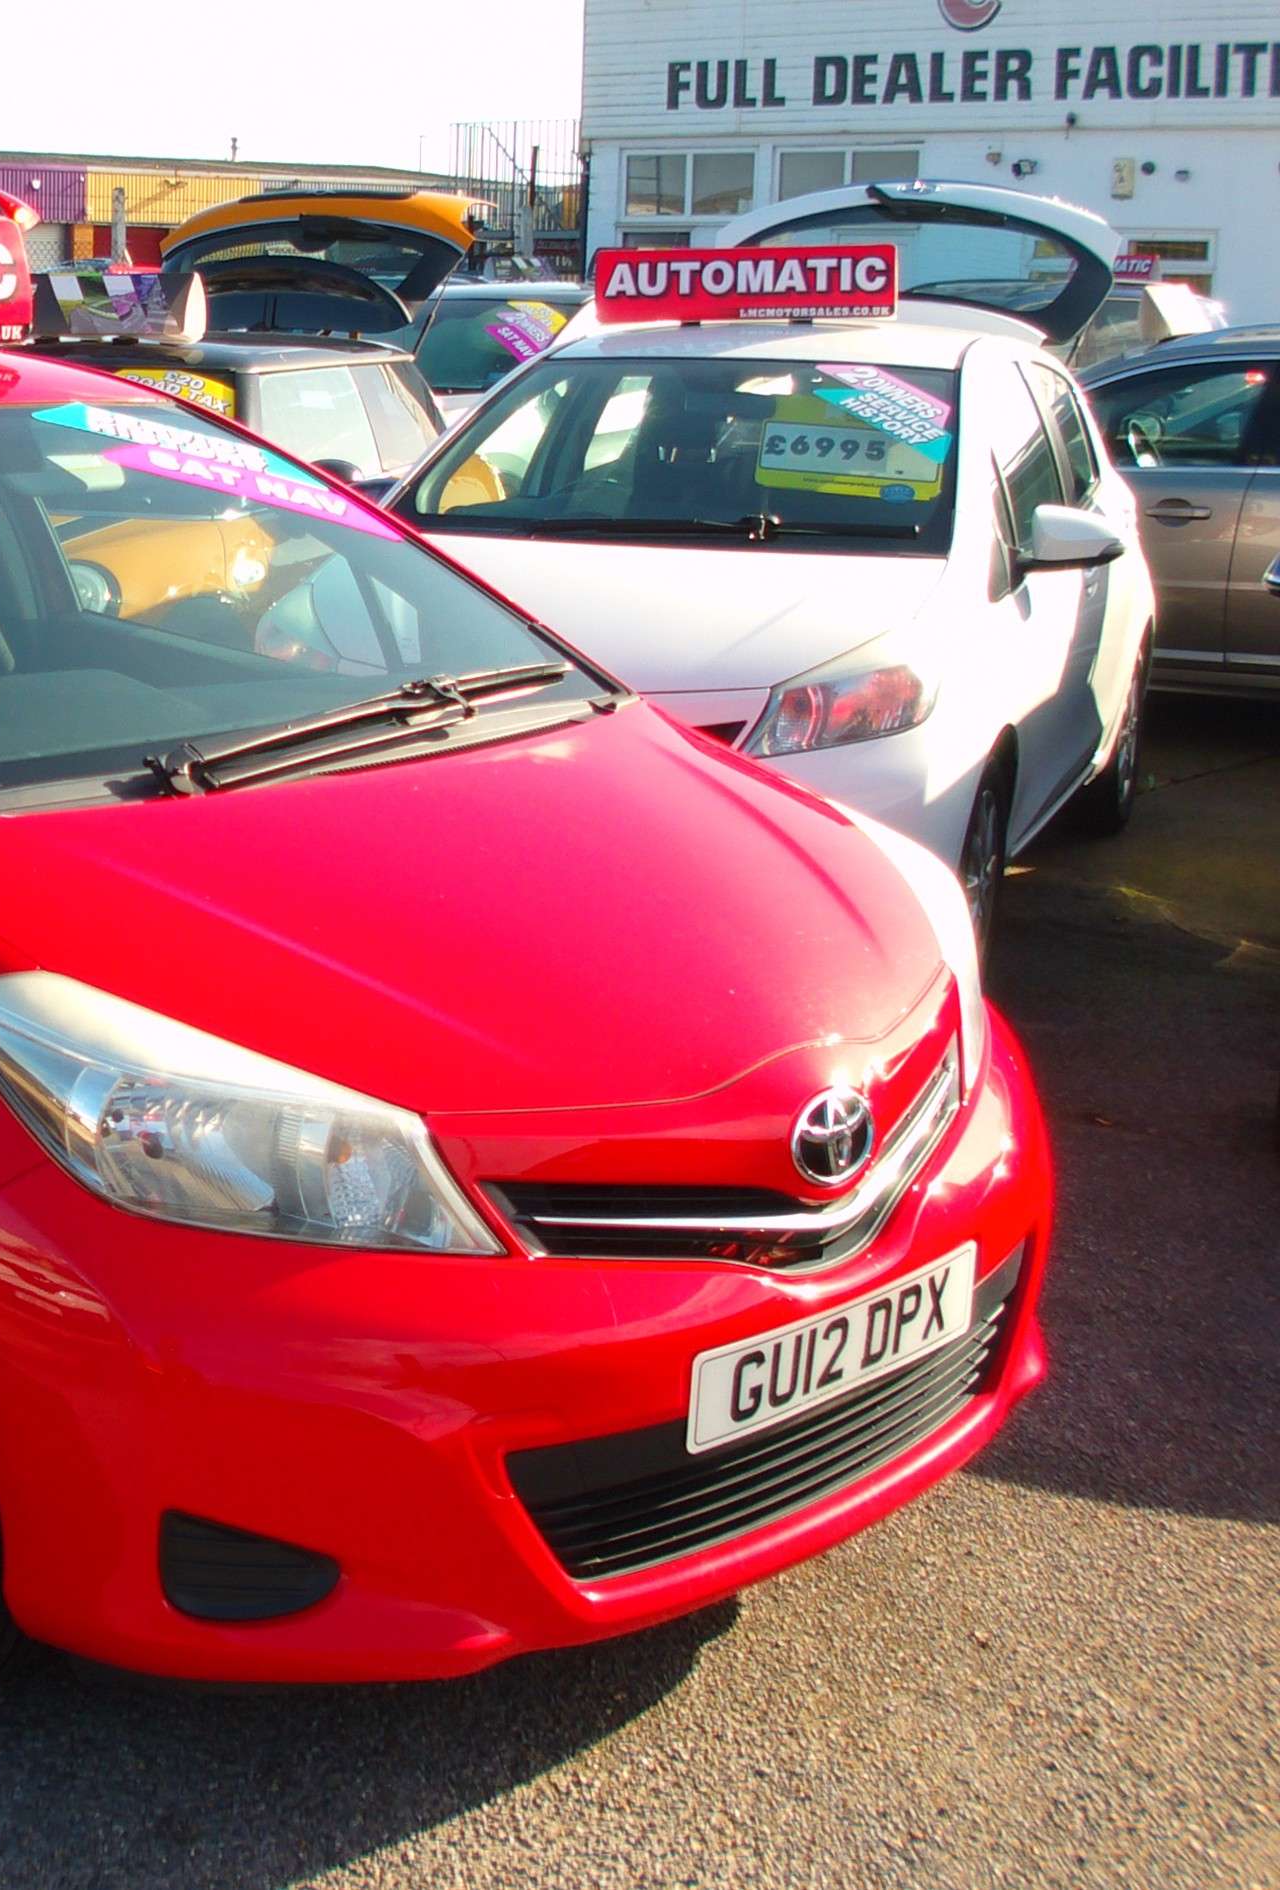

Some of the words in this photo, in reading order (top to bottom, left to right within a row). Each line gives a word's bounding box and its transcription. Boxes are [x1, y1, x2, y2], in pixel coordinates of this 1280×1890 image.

[666, 58, 786, 110] FULL
[812, 47, 1033, 107] DEALER
[604, 256, 888, 298] AUTOMATIC
[738, 304, 892, 319] LMCMOTORSALES.CO.UK
[836, 366, 879, 386] 2
[864, 376, 943, 420] OWNERS
[859, 390, 946, 441] SERVICE
[839, 396, 928, 444] HISTORY
[765, 434, 886, 462] £6995
[730, 1316, 850, 1423] GU12
[859, 1267, 951, 1370] DPX
